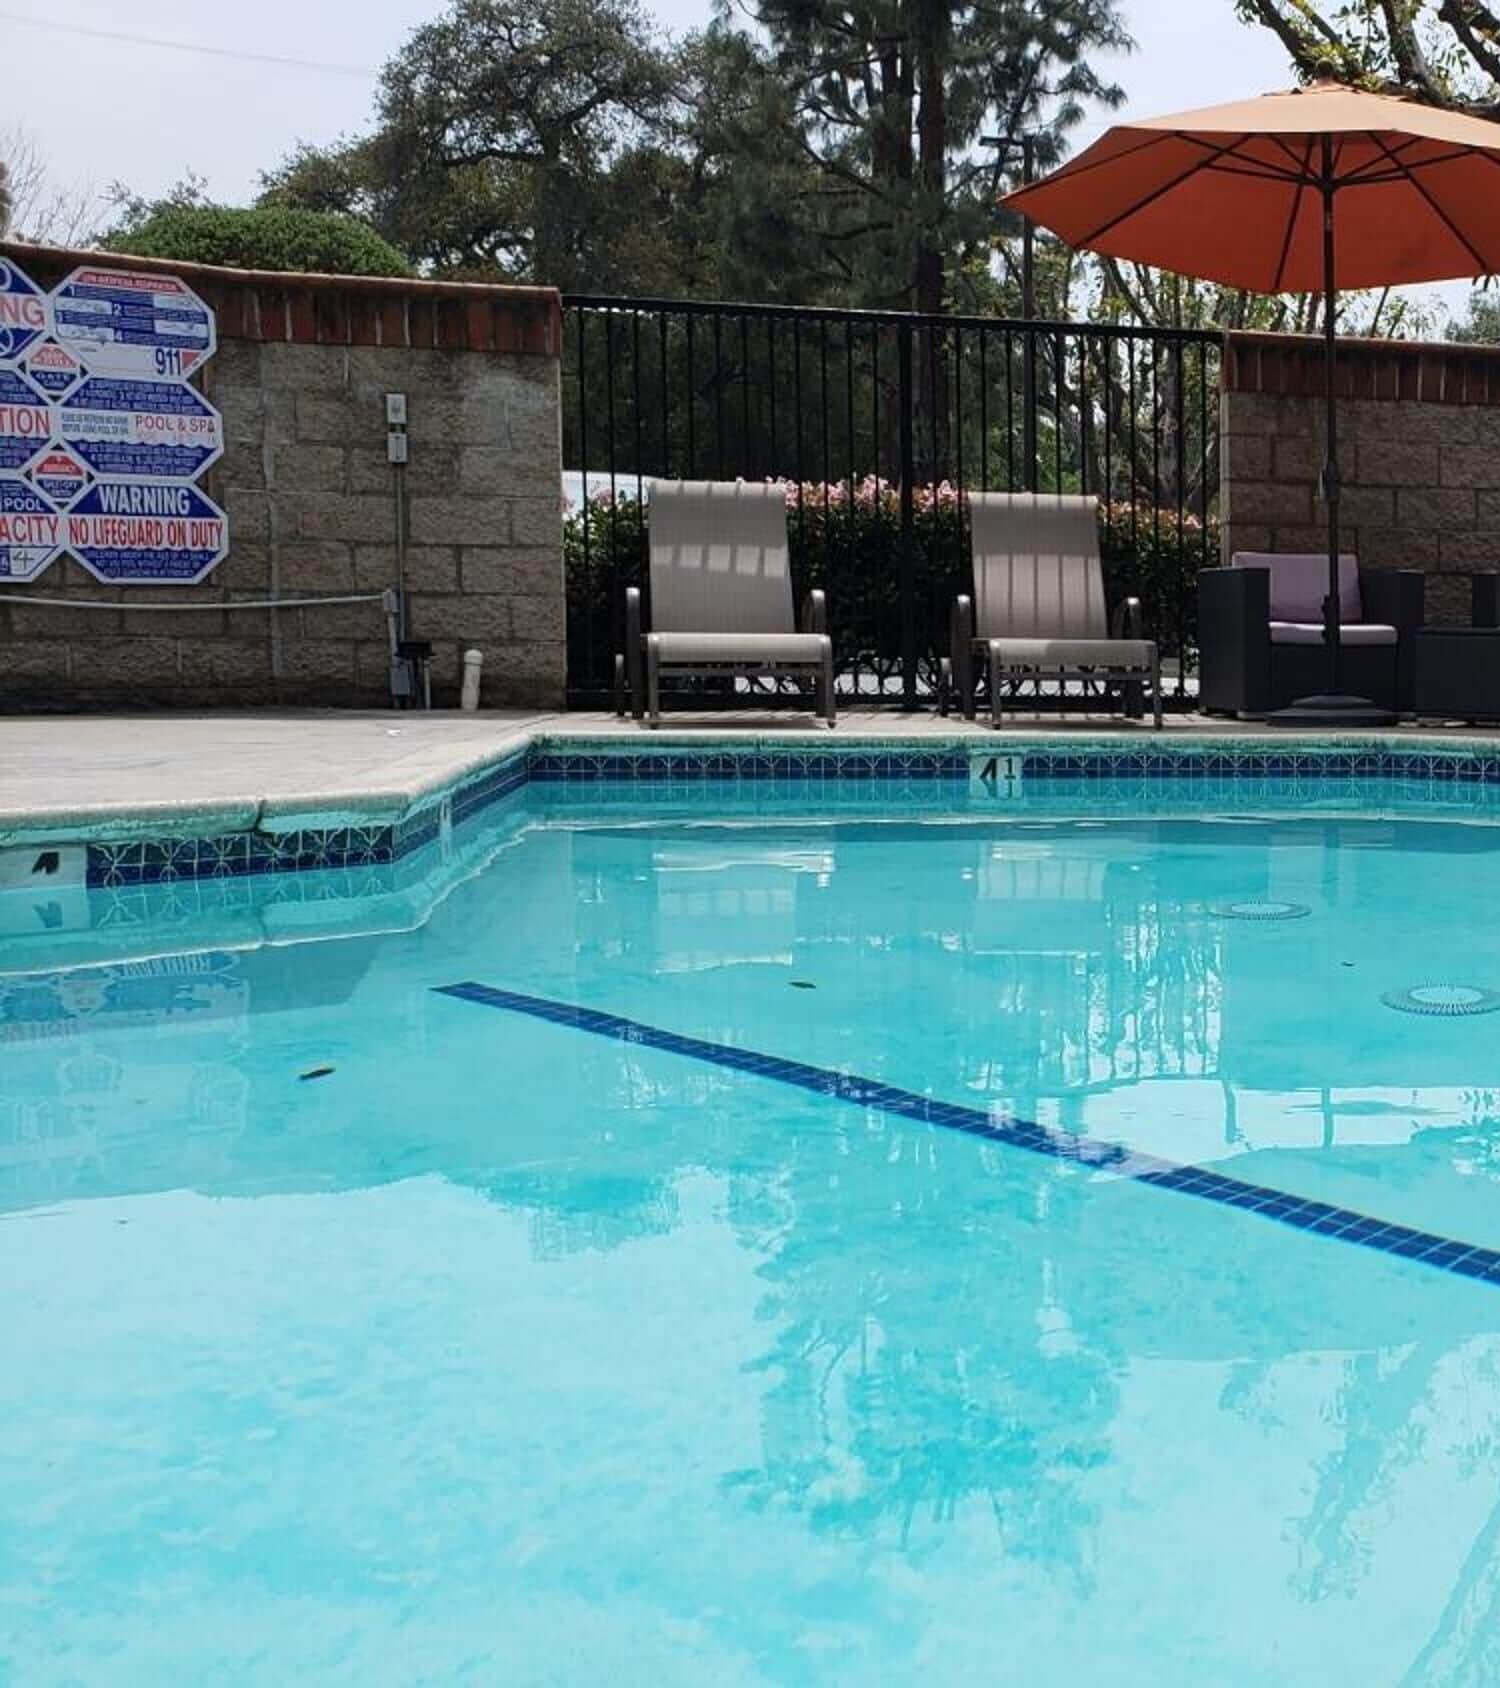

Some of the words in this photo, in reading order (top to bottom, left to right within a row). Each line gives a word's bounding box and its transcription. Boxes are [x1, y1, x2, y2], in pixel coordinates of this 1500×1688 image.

[155, 348, 181, 376] 911
[135, 415, 174, 432] POOL
[178, 418, 187, 432] &
[189, 419, 215, 433] SPA
[4, 497, 44, 512] POOL
[98, 485, 190, 515] WARNING
[69, 517, 88, 545] NO
[94, 518, 163, 547] LIFEGUARD
[167, 520, 186, 547] ON
[191, 521, 224, 548] DUTY
